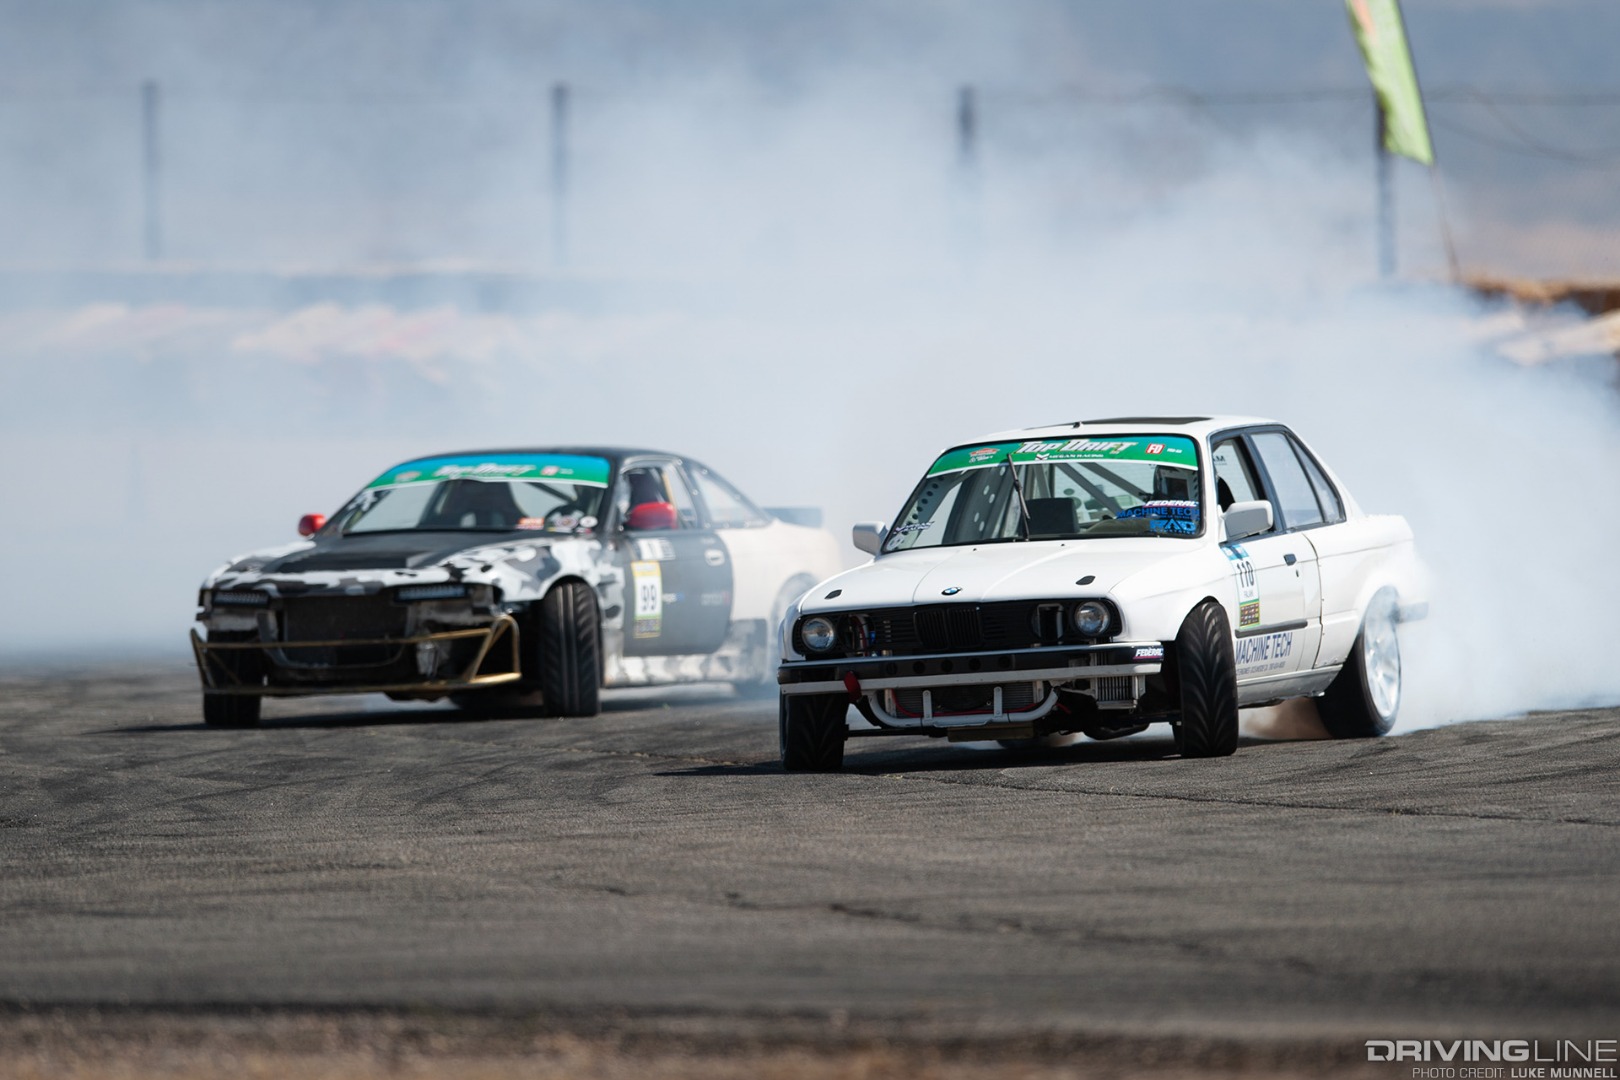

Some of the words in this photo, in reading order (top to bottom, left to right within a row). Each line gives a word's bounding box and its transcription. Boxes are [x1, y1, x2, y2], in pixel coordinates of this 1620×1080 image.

[1147, 443, 1162, 454] FD
[1116, 507, 1168, 519] MACHINE
[1169, 507, 1200, 517] TECH
[1237, 560, 1255, 588] 110
[641, 584, 657, 612] 99
[1235, 634, 1271, 665] MACHINE
[1271, 632, 1293, 659] TECH
